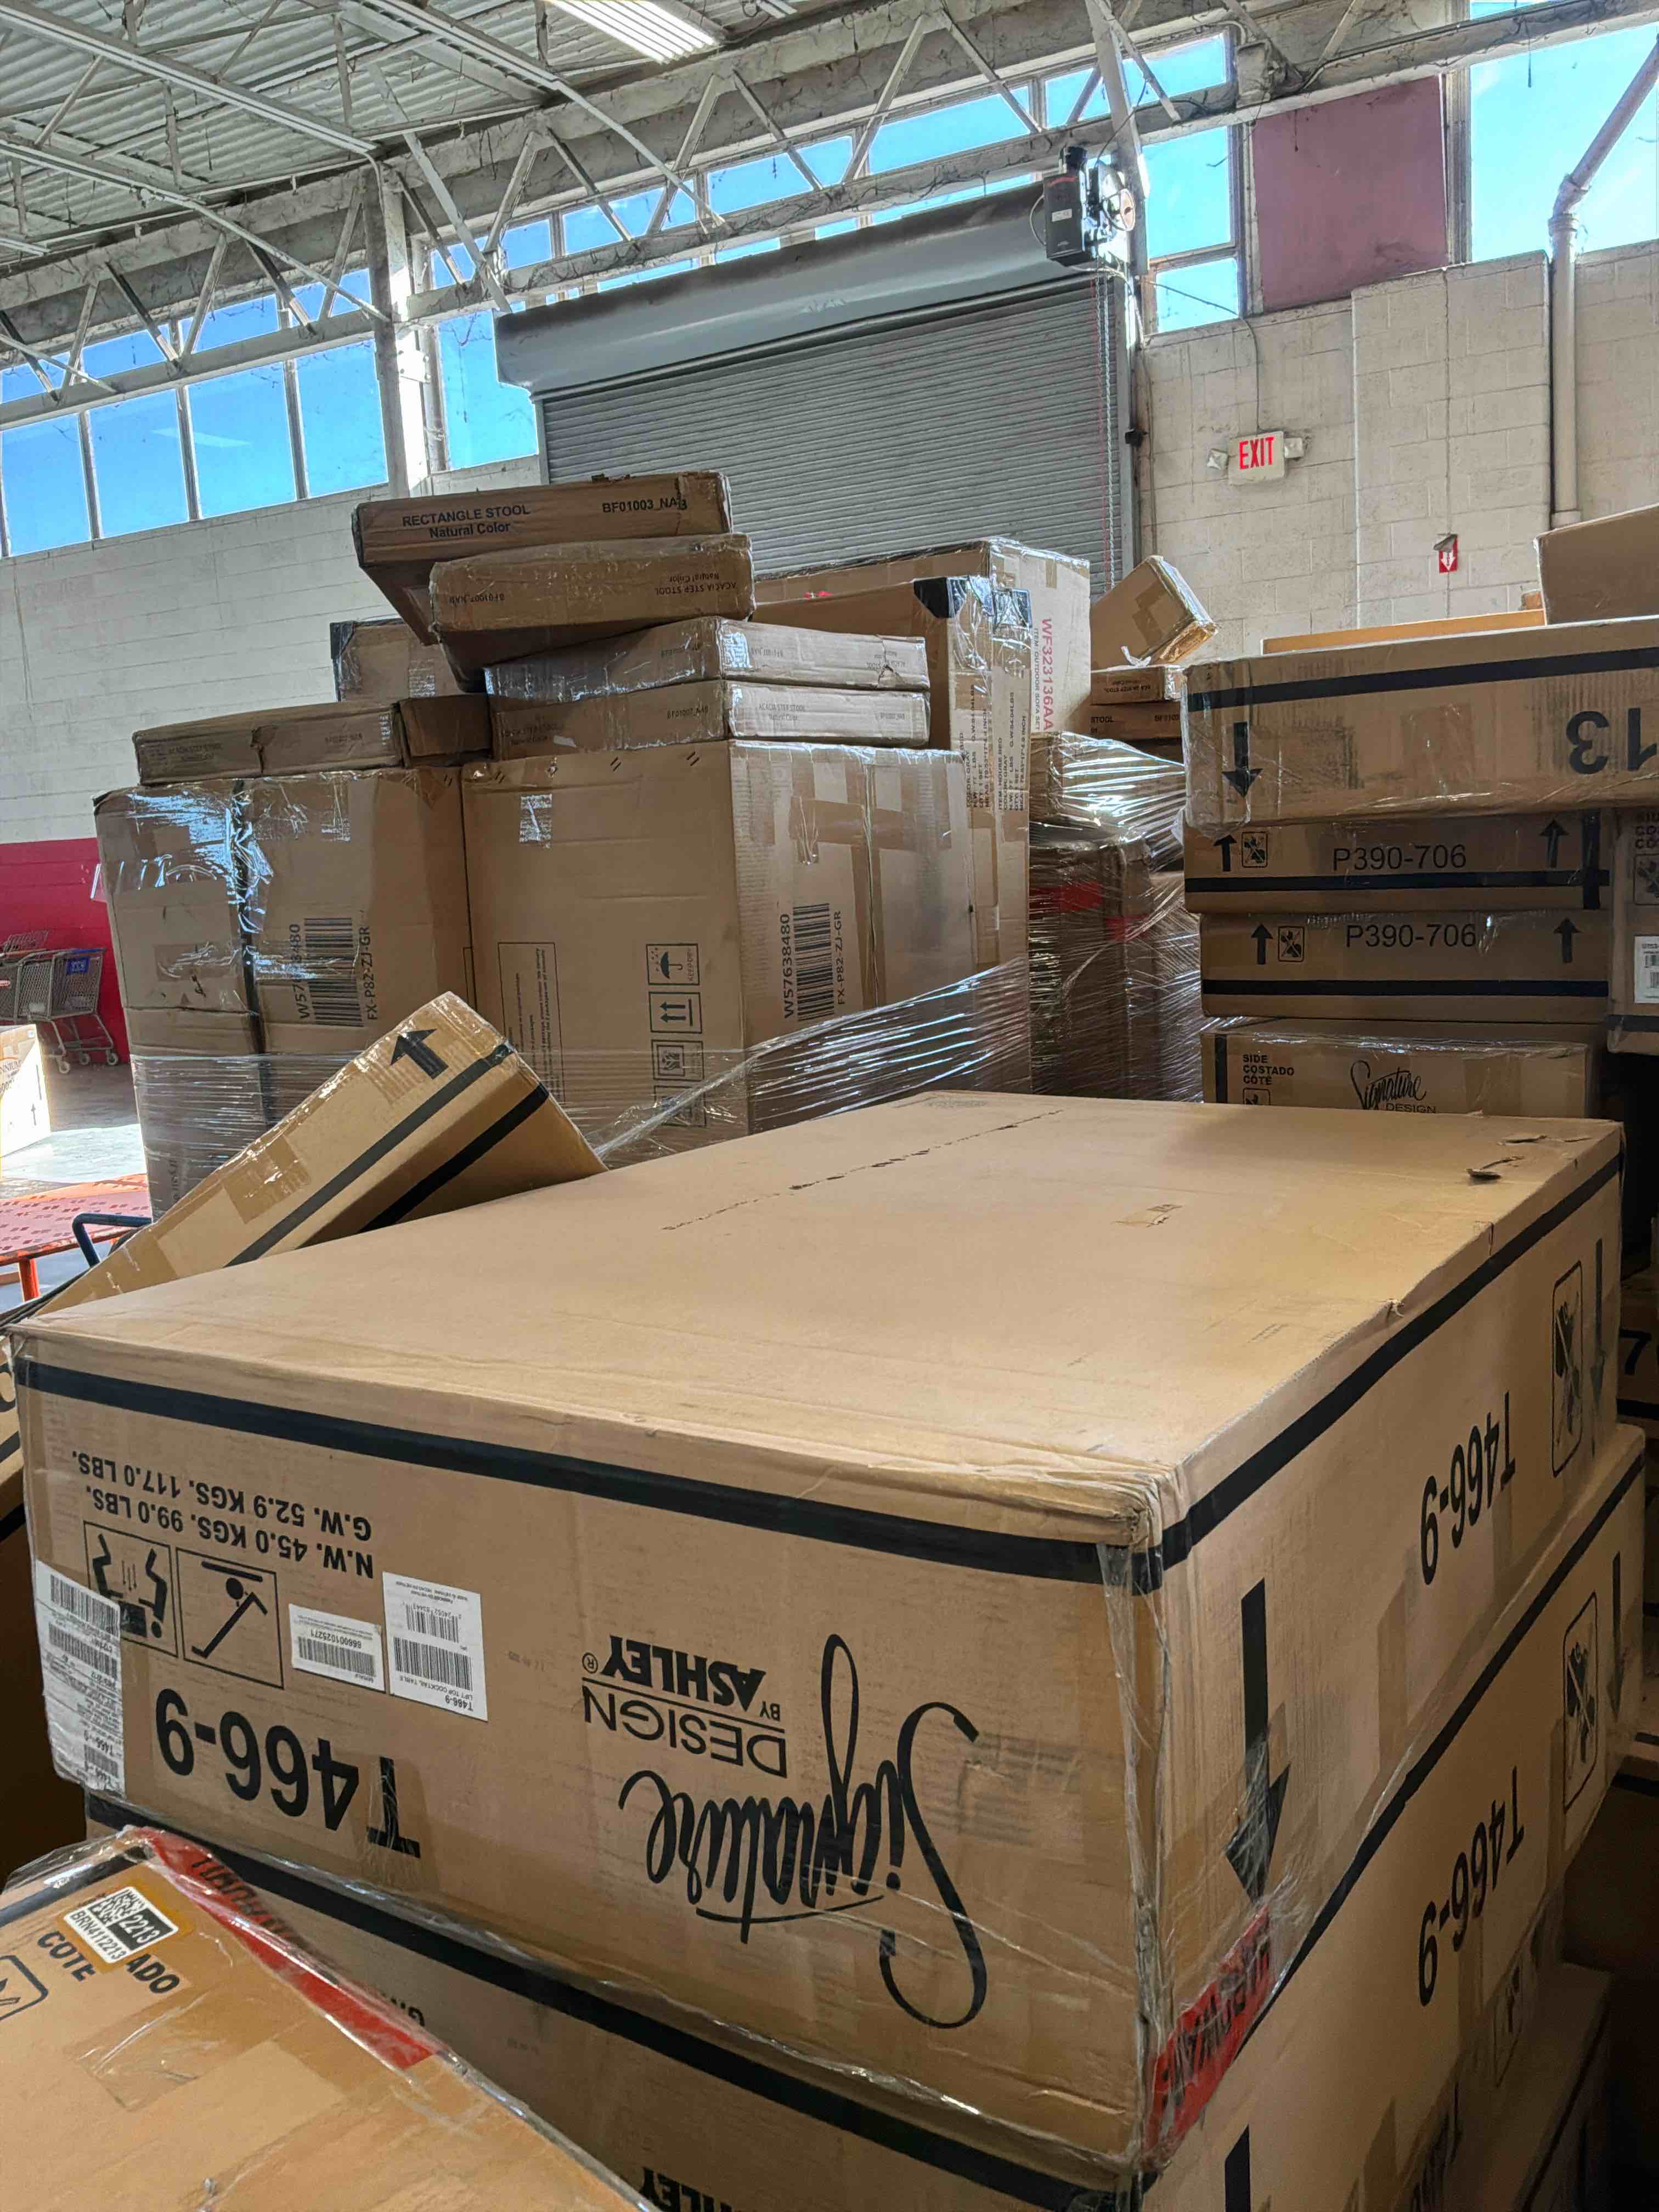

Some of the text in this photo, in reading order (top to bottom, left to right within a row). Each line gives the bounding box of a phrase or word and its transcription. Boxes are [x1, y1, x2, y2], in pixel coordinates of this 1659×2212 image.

[1238, 437, 1274, 469] EXIT
[403, 505, 530, 527] RECTANGLE STOOL
[430, 521, 510, 538] Natural Color
[654, 582, 737, 595] ACACIA STEP STOOL
[693, 573, 719, 582] Natural
[1041, 618, 1053, 730] WF323136AA
[1333, 844, 1467, 871] P390-706
[833, 911, 845, 1005] FX-P82-ZJ-GR
[1346, 923, 1477, 948] P390-706
[780, 913, 794, 1019] W57638480
[1243, 1054, 1268, 1063] SIDE
[1243, 1065, 1295, 1075] COSTADO
[1351, 1059, 1427, 1110] Signature
[1386, 1103, 1437, 1113] DESIGN
[72, 1449, 371, 1543] G.W. 52.9 KGS. 117.0 LBS.
[1421, 1391, 1516, 1585] T466-9
[86, 1485, 374, 1579] N.W. 45.0 KGS. 99.0 LBS.
[601, 1634, 767, 1711] ASHLEY
[582, 1685, 788, 1779] DESIGN
[759, 1700, 781, 1722] BY
[155, 1688, 421, 1859] T466-9
[618, 1633, 988, 2030] Signature
[1418, 1764, 1525, 2006] T466-9
[71, 1910, 127, 1960] BRN4112213
[119, 1914, 160, 1944] 2213
